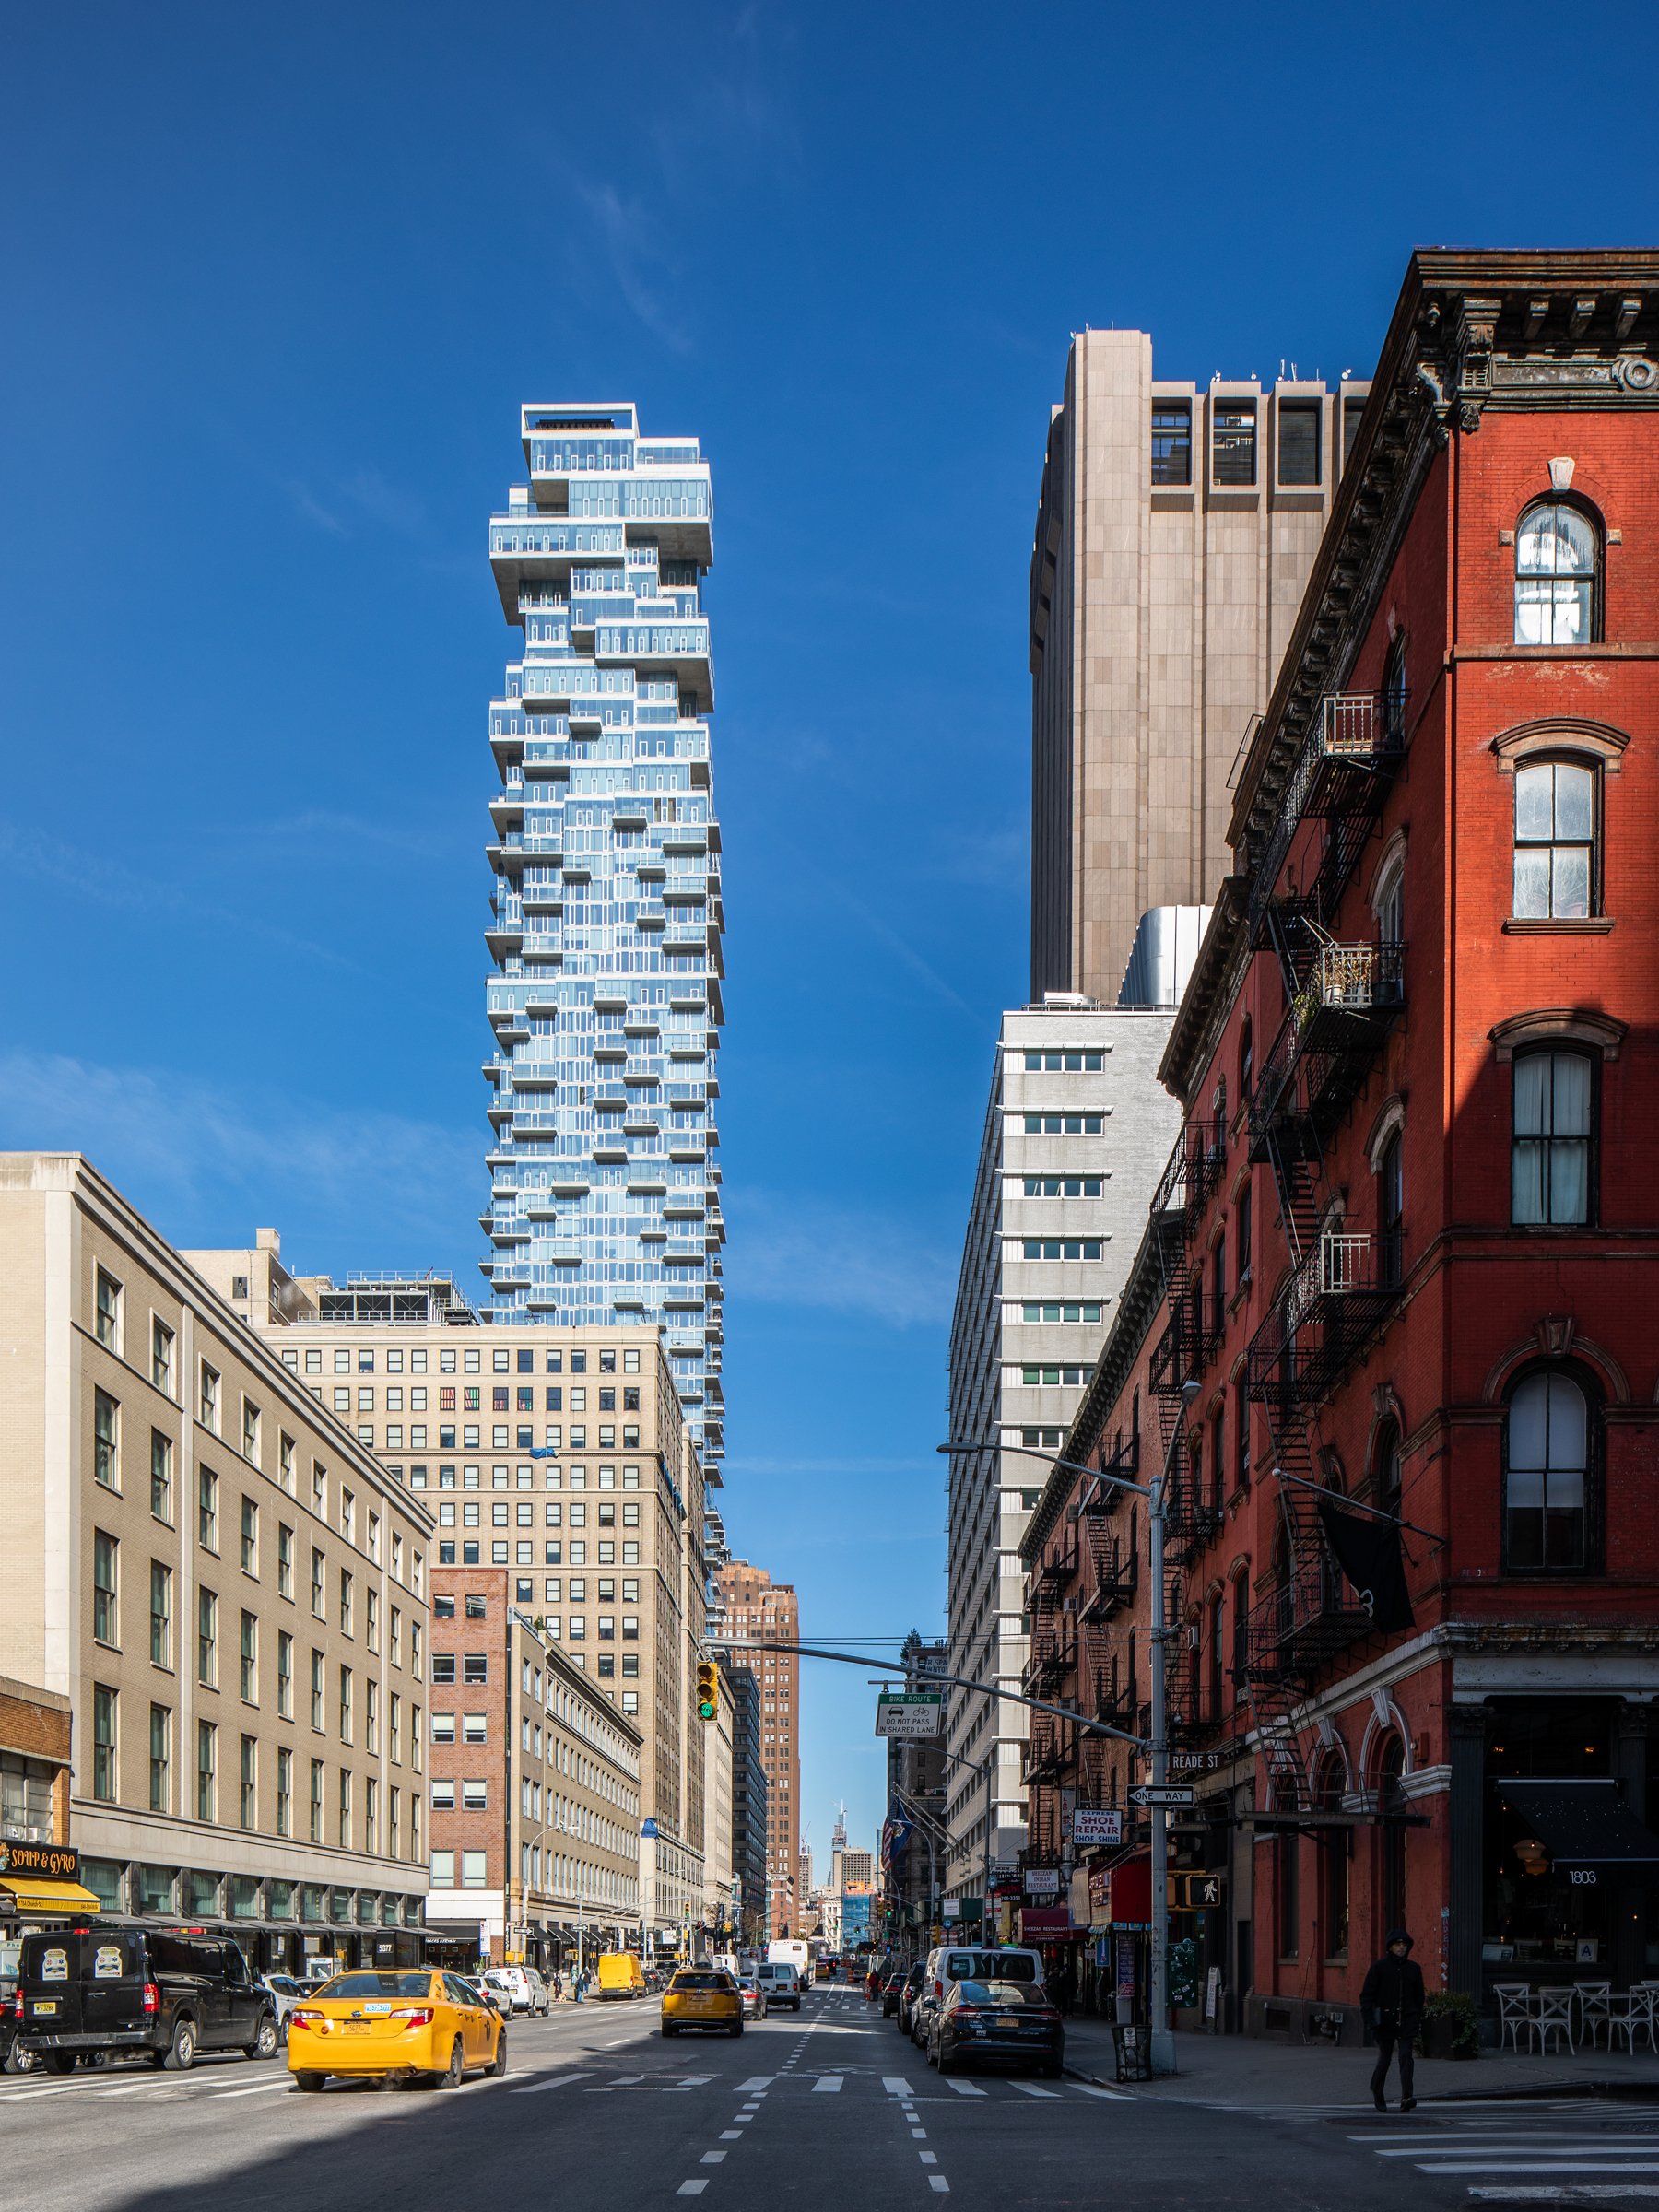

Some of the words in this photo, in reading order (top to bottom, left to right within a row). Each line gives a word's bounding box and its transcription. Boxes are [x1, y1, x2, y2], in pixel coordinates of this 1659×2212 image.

[1172, 1755, 1203, 1769] READE
[1207, 1755, 1219, 1768] ST
[1135, 1792, 1154, 1800] ONE
[1165, 1792, 1184, 1800] WAY
[1080, 1817, 1115, 1825] SHOE
[1076, 1826, 1119, 1834] REPAIR
[12, 1849, 40, 1867] SOUP
[41, 1852, 49, 1868] &
[50, 1853, 76, 1874] GYRO
[1569, 1870, 1596, 1884] 1803
[378, 1944, 392, 1952] 5G77
[1582, 1946, 1592, 1956] A
